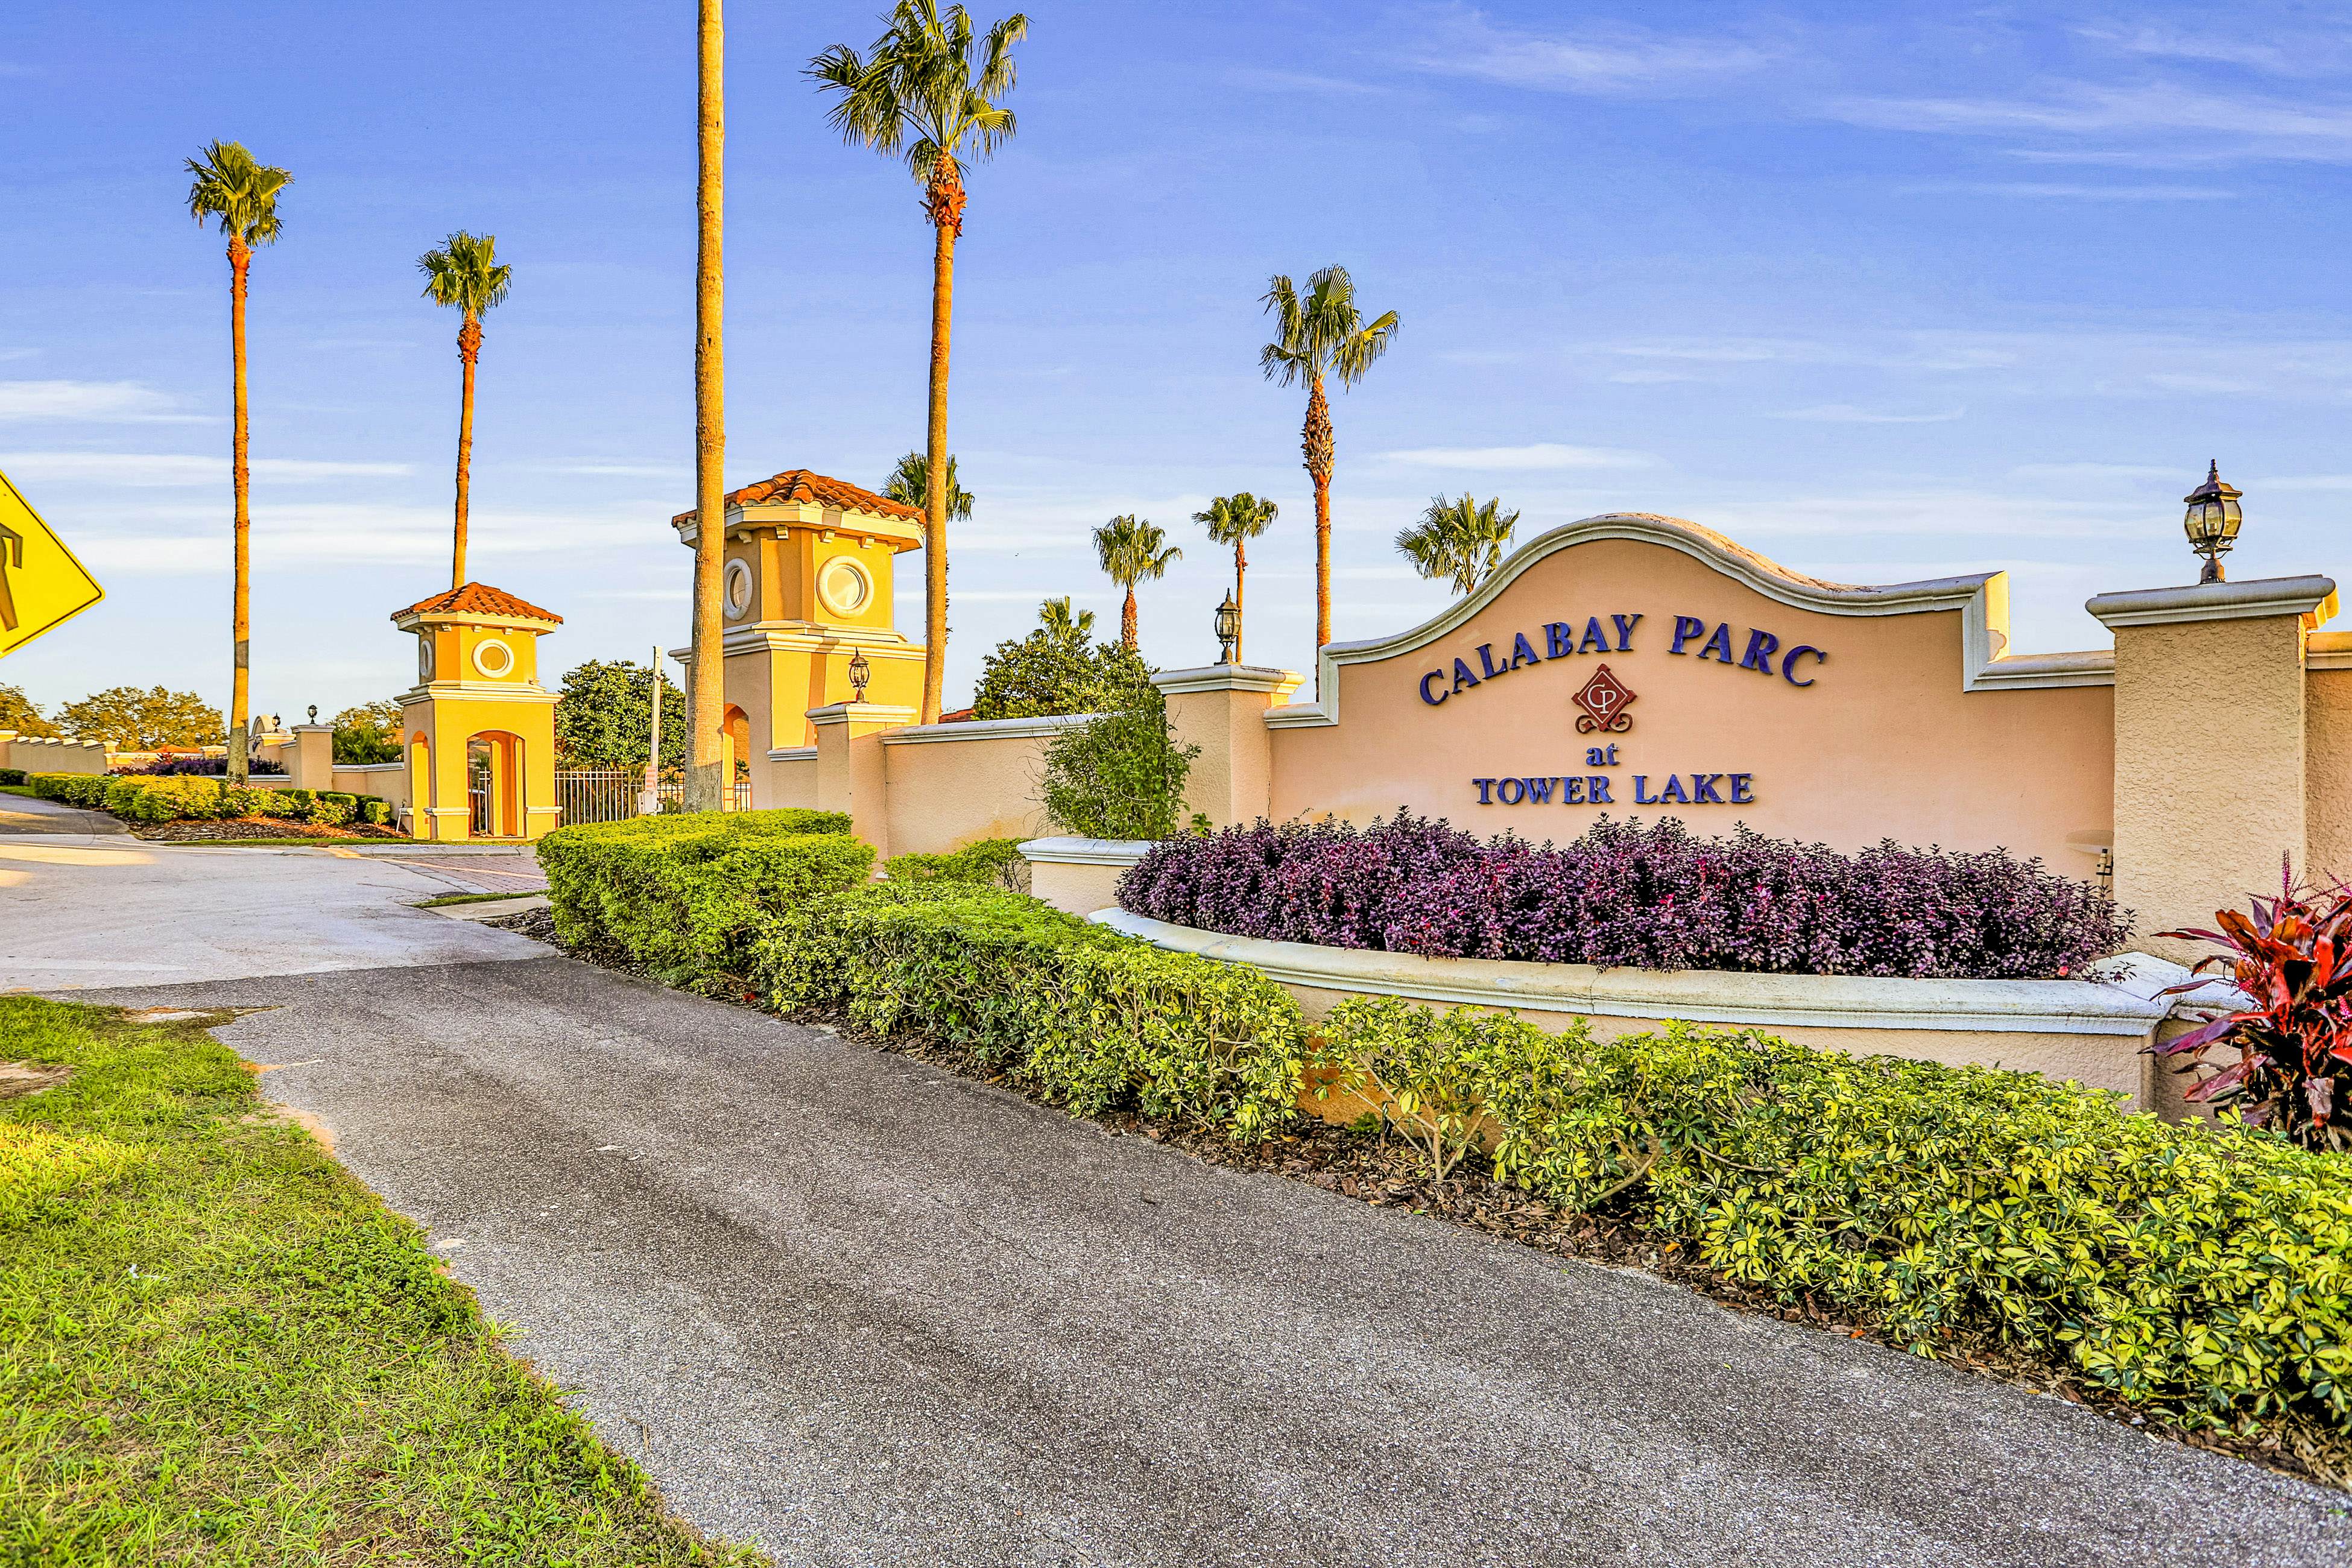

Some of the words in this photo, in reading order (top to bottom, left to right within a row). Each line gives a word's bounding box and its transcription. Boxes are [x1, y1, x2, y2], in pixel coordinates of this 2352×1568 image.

[1419, 613, 1643, 705] CALABAY
[1667, 615, 1827, 686] PARC
[1585, 743, 1620, 766] at
[1472, 776, 1615, 804] TOWER
[1631, 773, 1755, 804] LAKE
